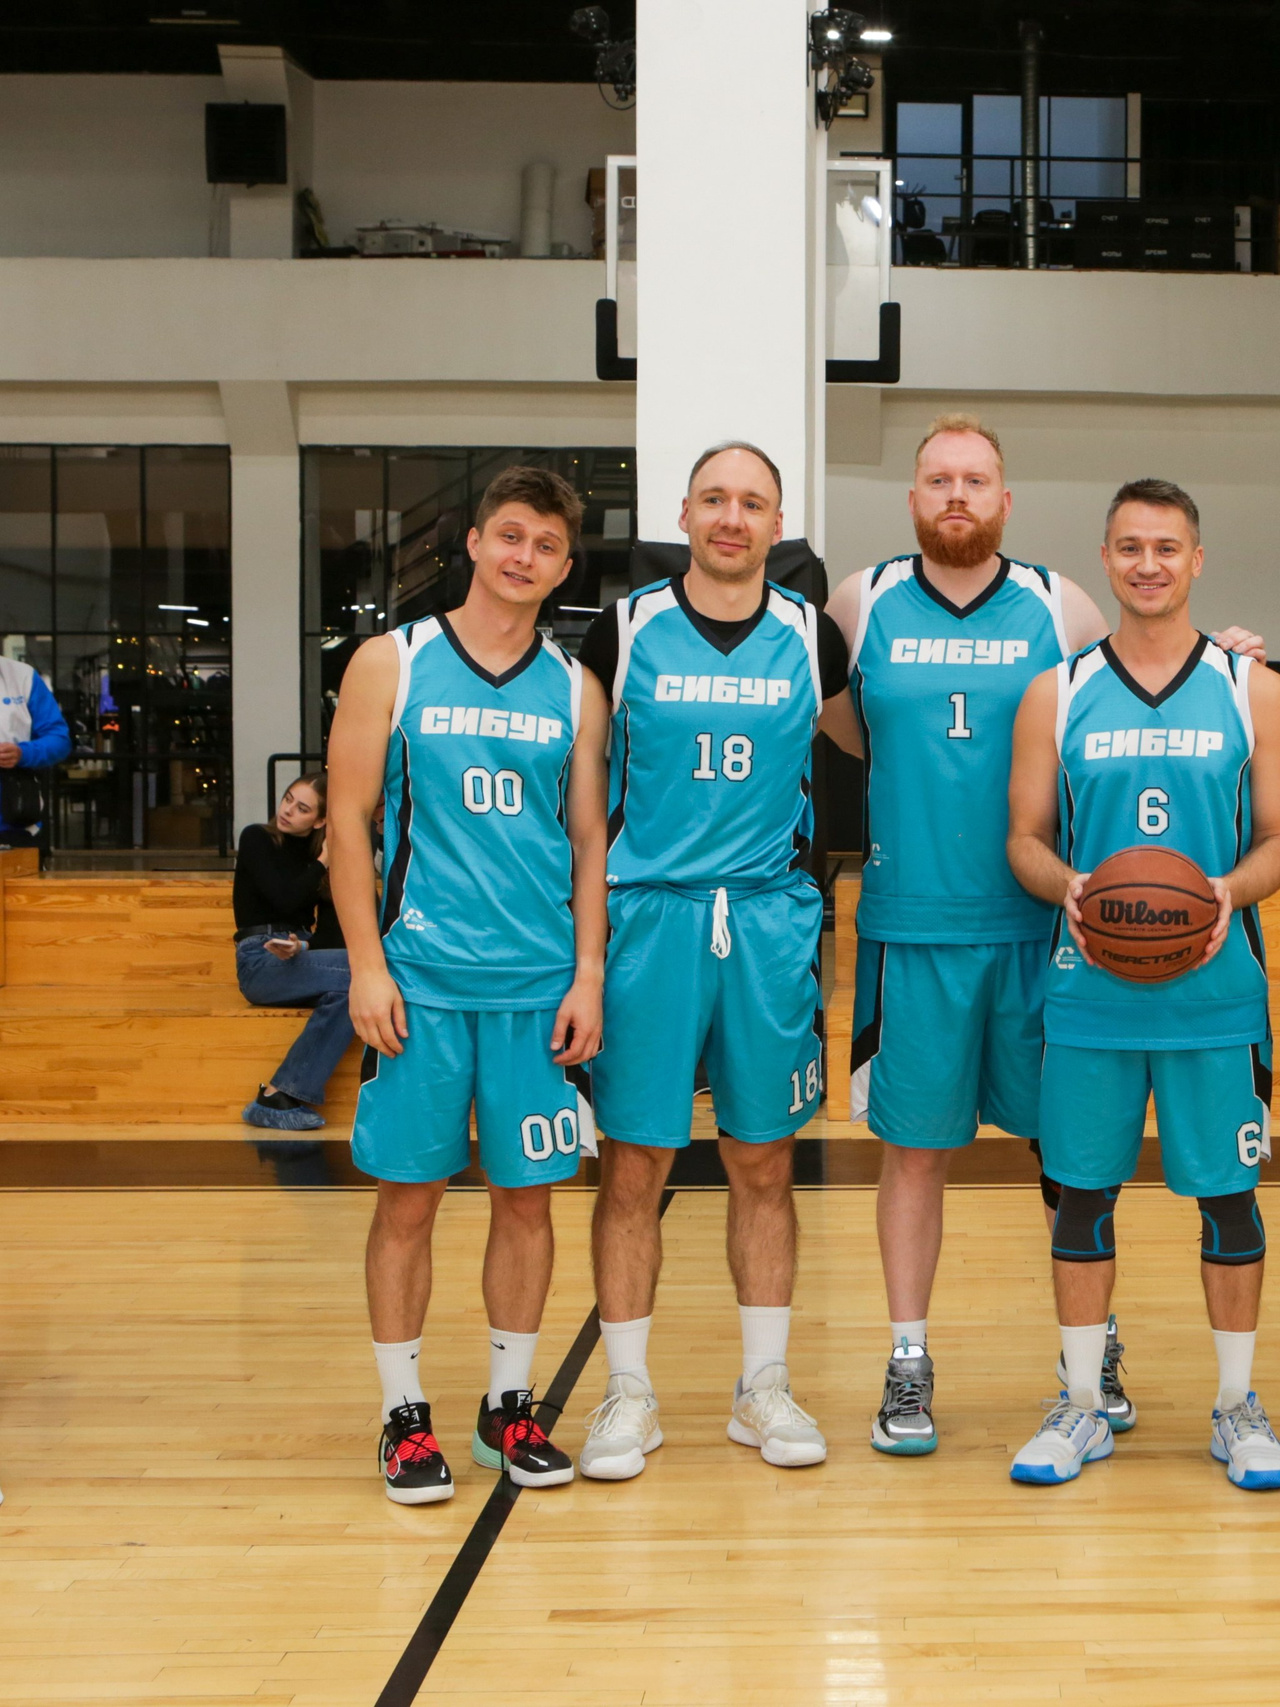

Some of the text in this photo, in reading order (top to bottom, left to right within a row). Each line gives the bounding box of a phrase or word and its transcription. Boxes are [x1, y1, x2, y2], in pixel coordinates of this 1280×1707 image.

[889, 638, 1030, 665] СИБУР
[654, 674, 791, 706] СИБУР
[420, 706, 562, 744] СИБУР
[946, 692, 972, 740] 1
[692, 732, 754, 782] 18
[1084, 728, 1224, 761] СИБУР
[461, 766, 524, 817] 00
[1136, 787, 1170, 836] 6
[1099, 899, 1190, 926] Wilson
[1101, 946, 1192, 965] REACTION
[788, 1058, 818, 1116] 18
[520, 1107, 580, 1163] 00
[1235, 1120, 1263, 1169] 6
